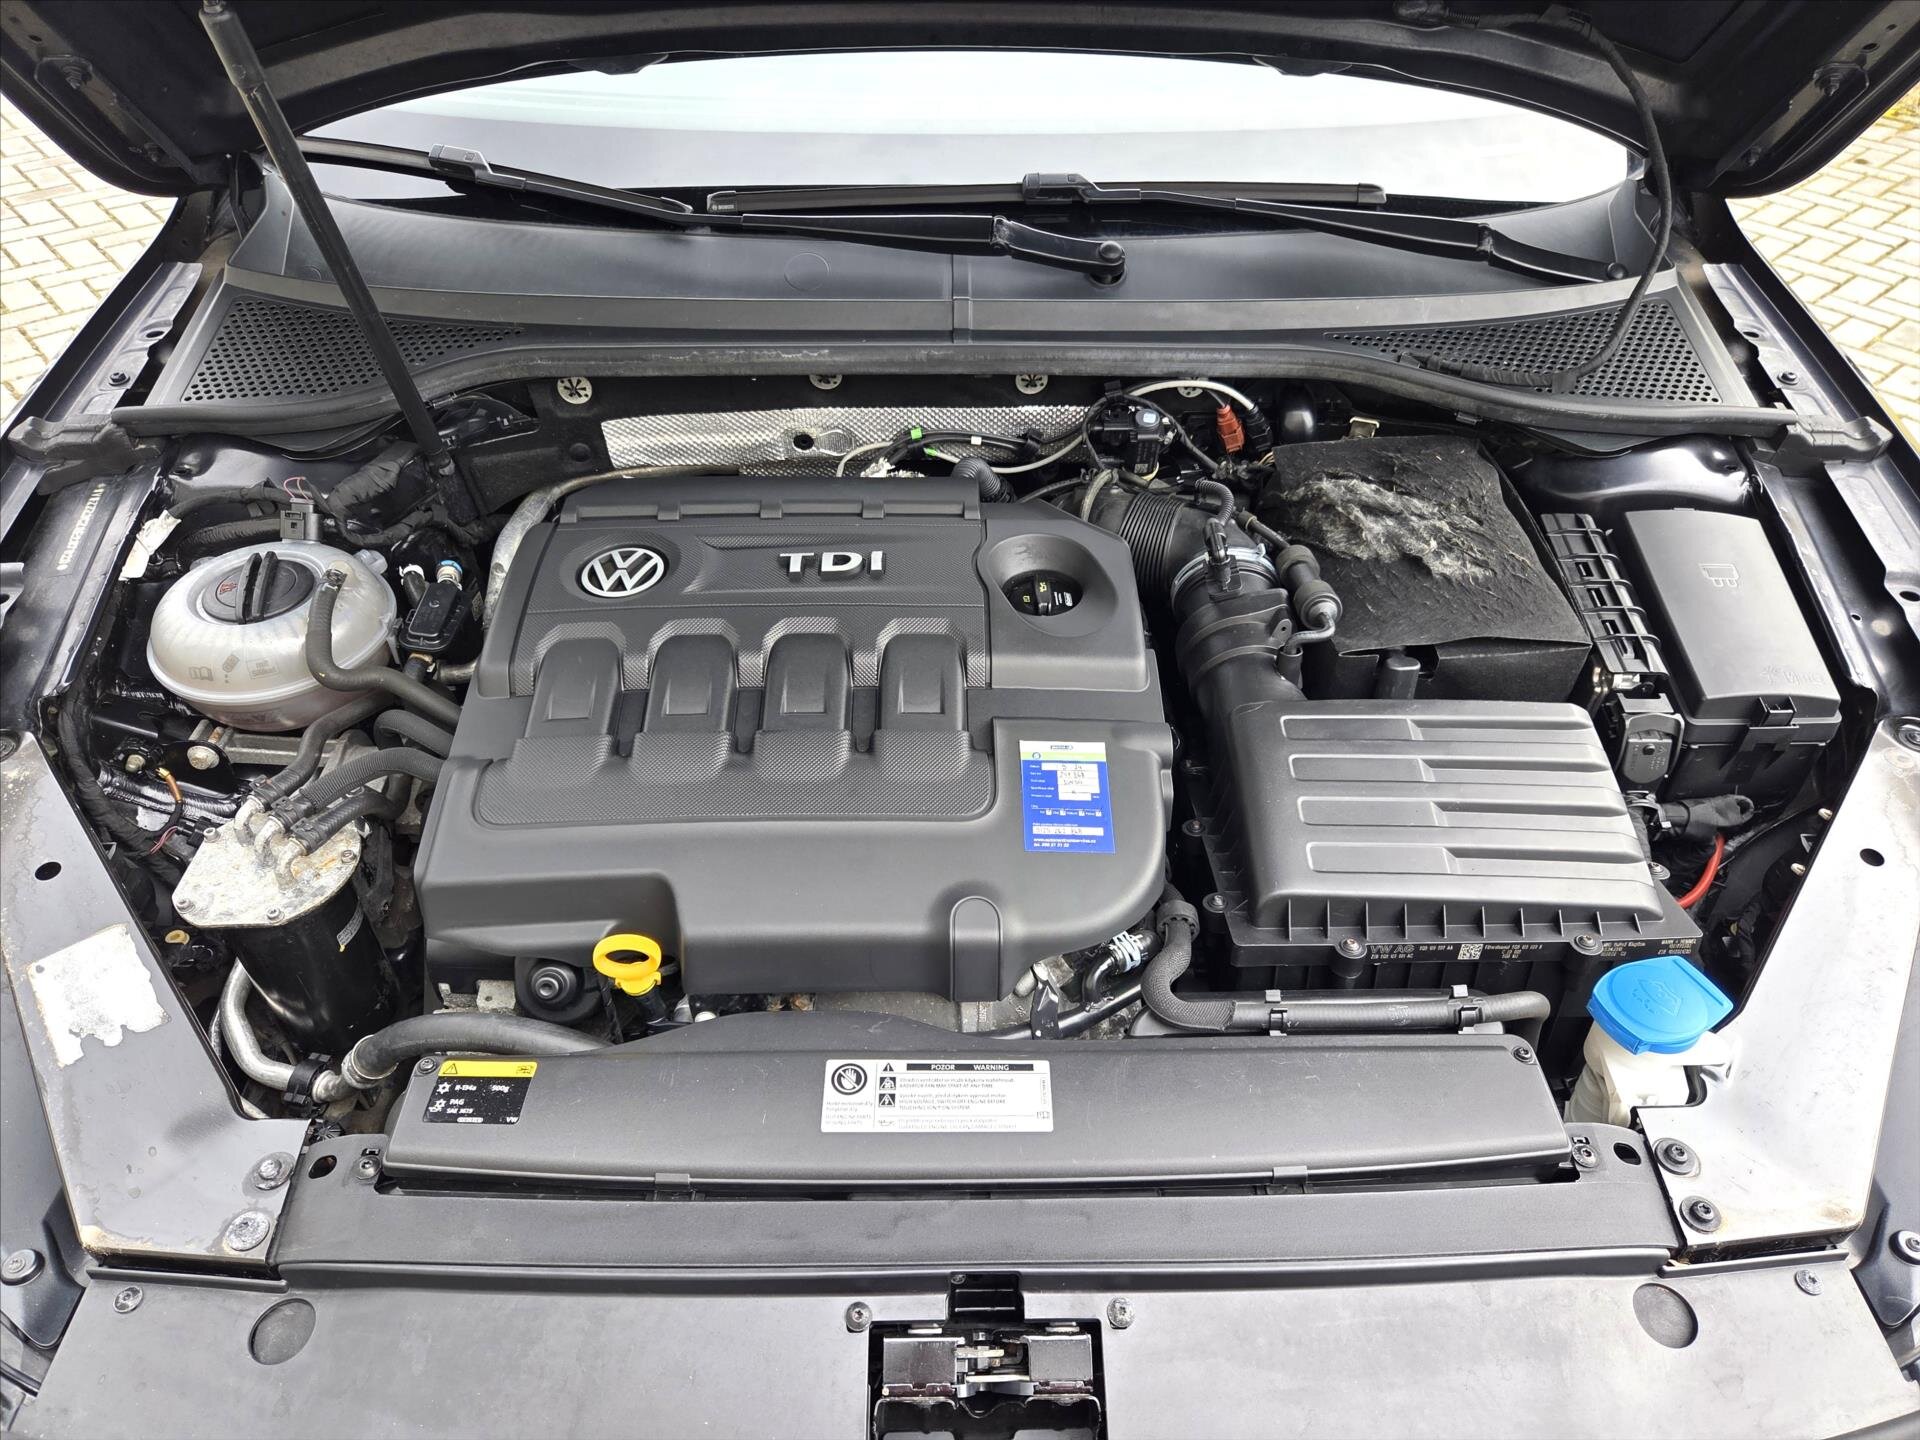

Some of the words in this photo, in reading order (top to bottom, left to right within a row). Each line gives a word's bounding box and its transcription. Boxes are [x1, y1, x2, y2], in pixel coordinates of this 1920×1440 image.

[779, 551, 884, 579] TDI
[1370, 945, 1393, 954] VW
[1394, 944, 1415, 953] AG
